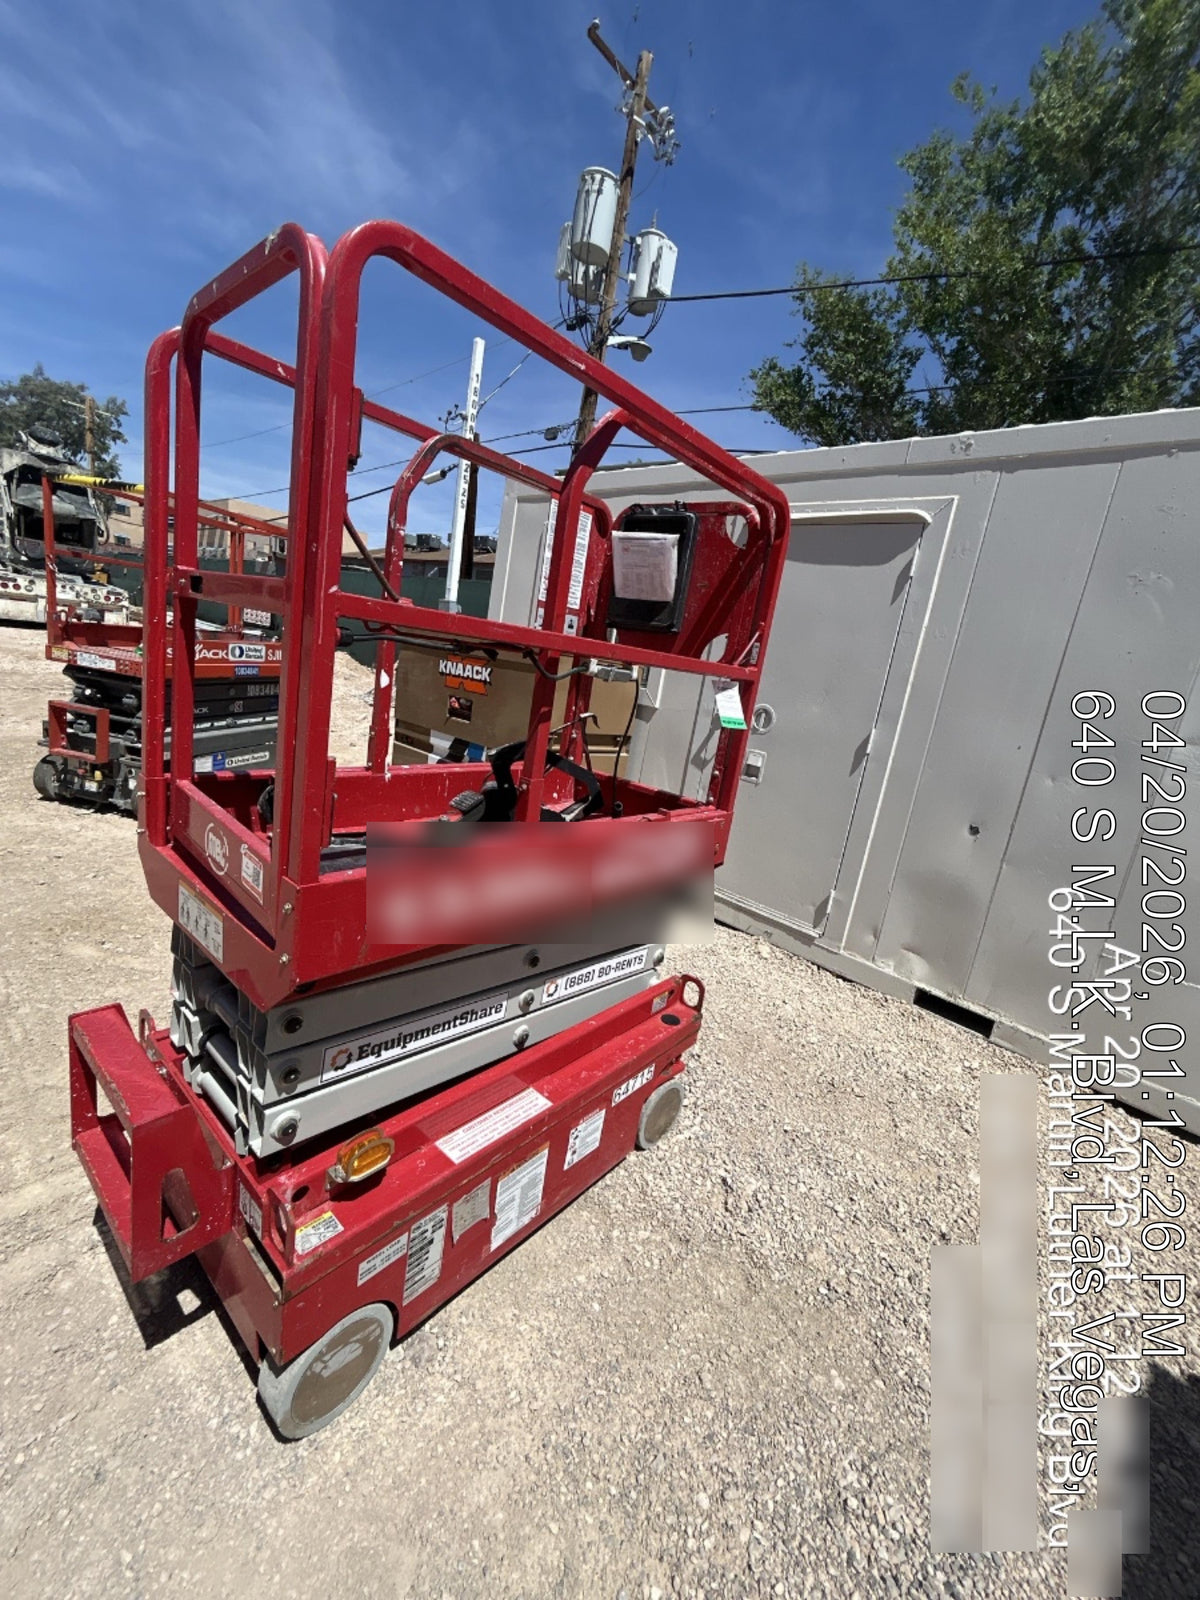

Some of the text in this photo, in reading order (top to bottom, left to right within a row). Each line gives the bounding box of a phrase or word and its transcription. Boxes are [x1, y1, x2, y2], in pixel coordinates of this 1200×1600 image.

[439, 659, 492, 682] KNAACK
[564, 954, 644, 990] (888) 80-RENTS
[356, 1003, 503, 1061] EquipmentShare
[613, 1064, 653, 1104] 64715
